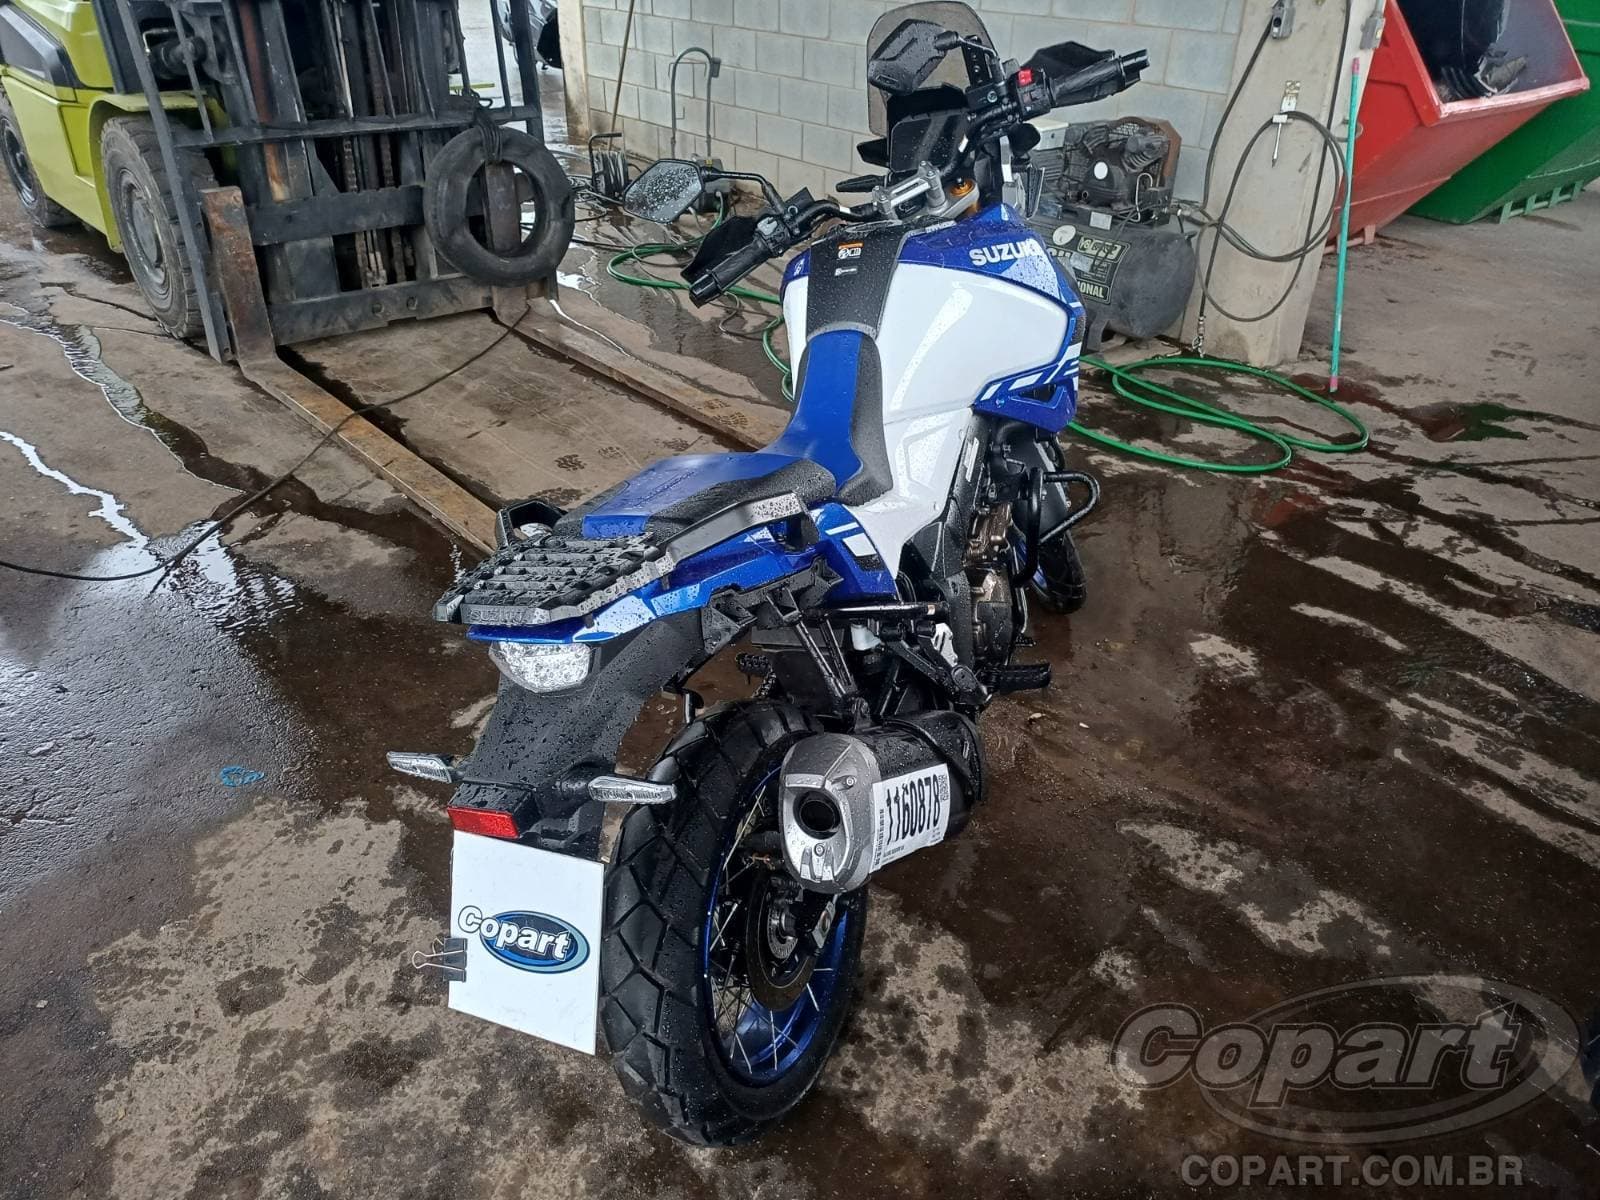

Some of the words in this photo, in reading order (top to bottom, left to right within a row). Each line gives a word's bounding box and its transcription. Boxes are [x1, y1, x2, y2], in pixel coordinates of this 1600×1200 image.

[969, 238, 1042, 266] SUZUK
[886, 774, 941, 846] 1160878
[458, 905, 571, 961] Copart
